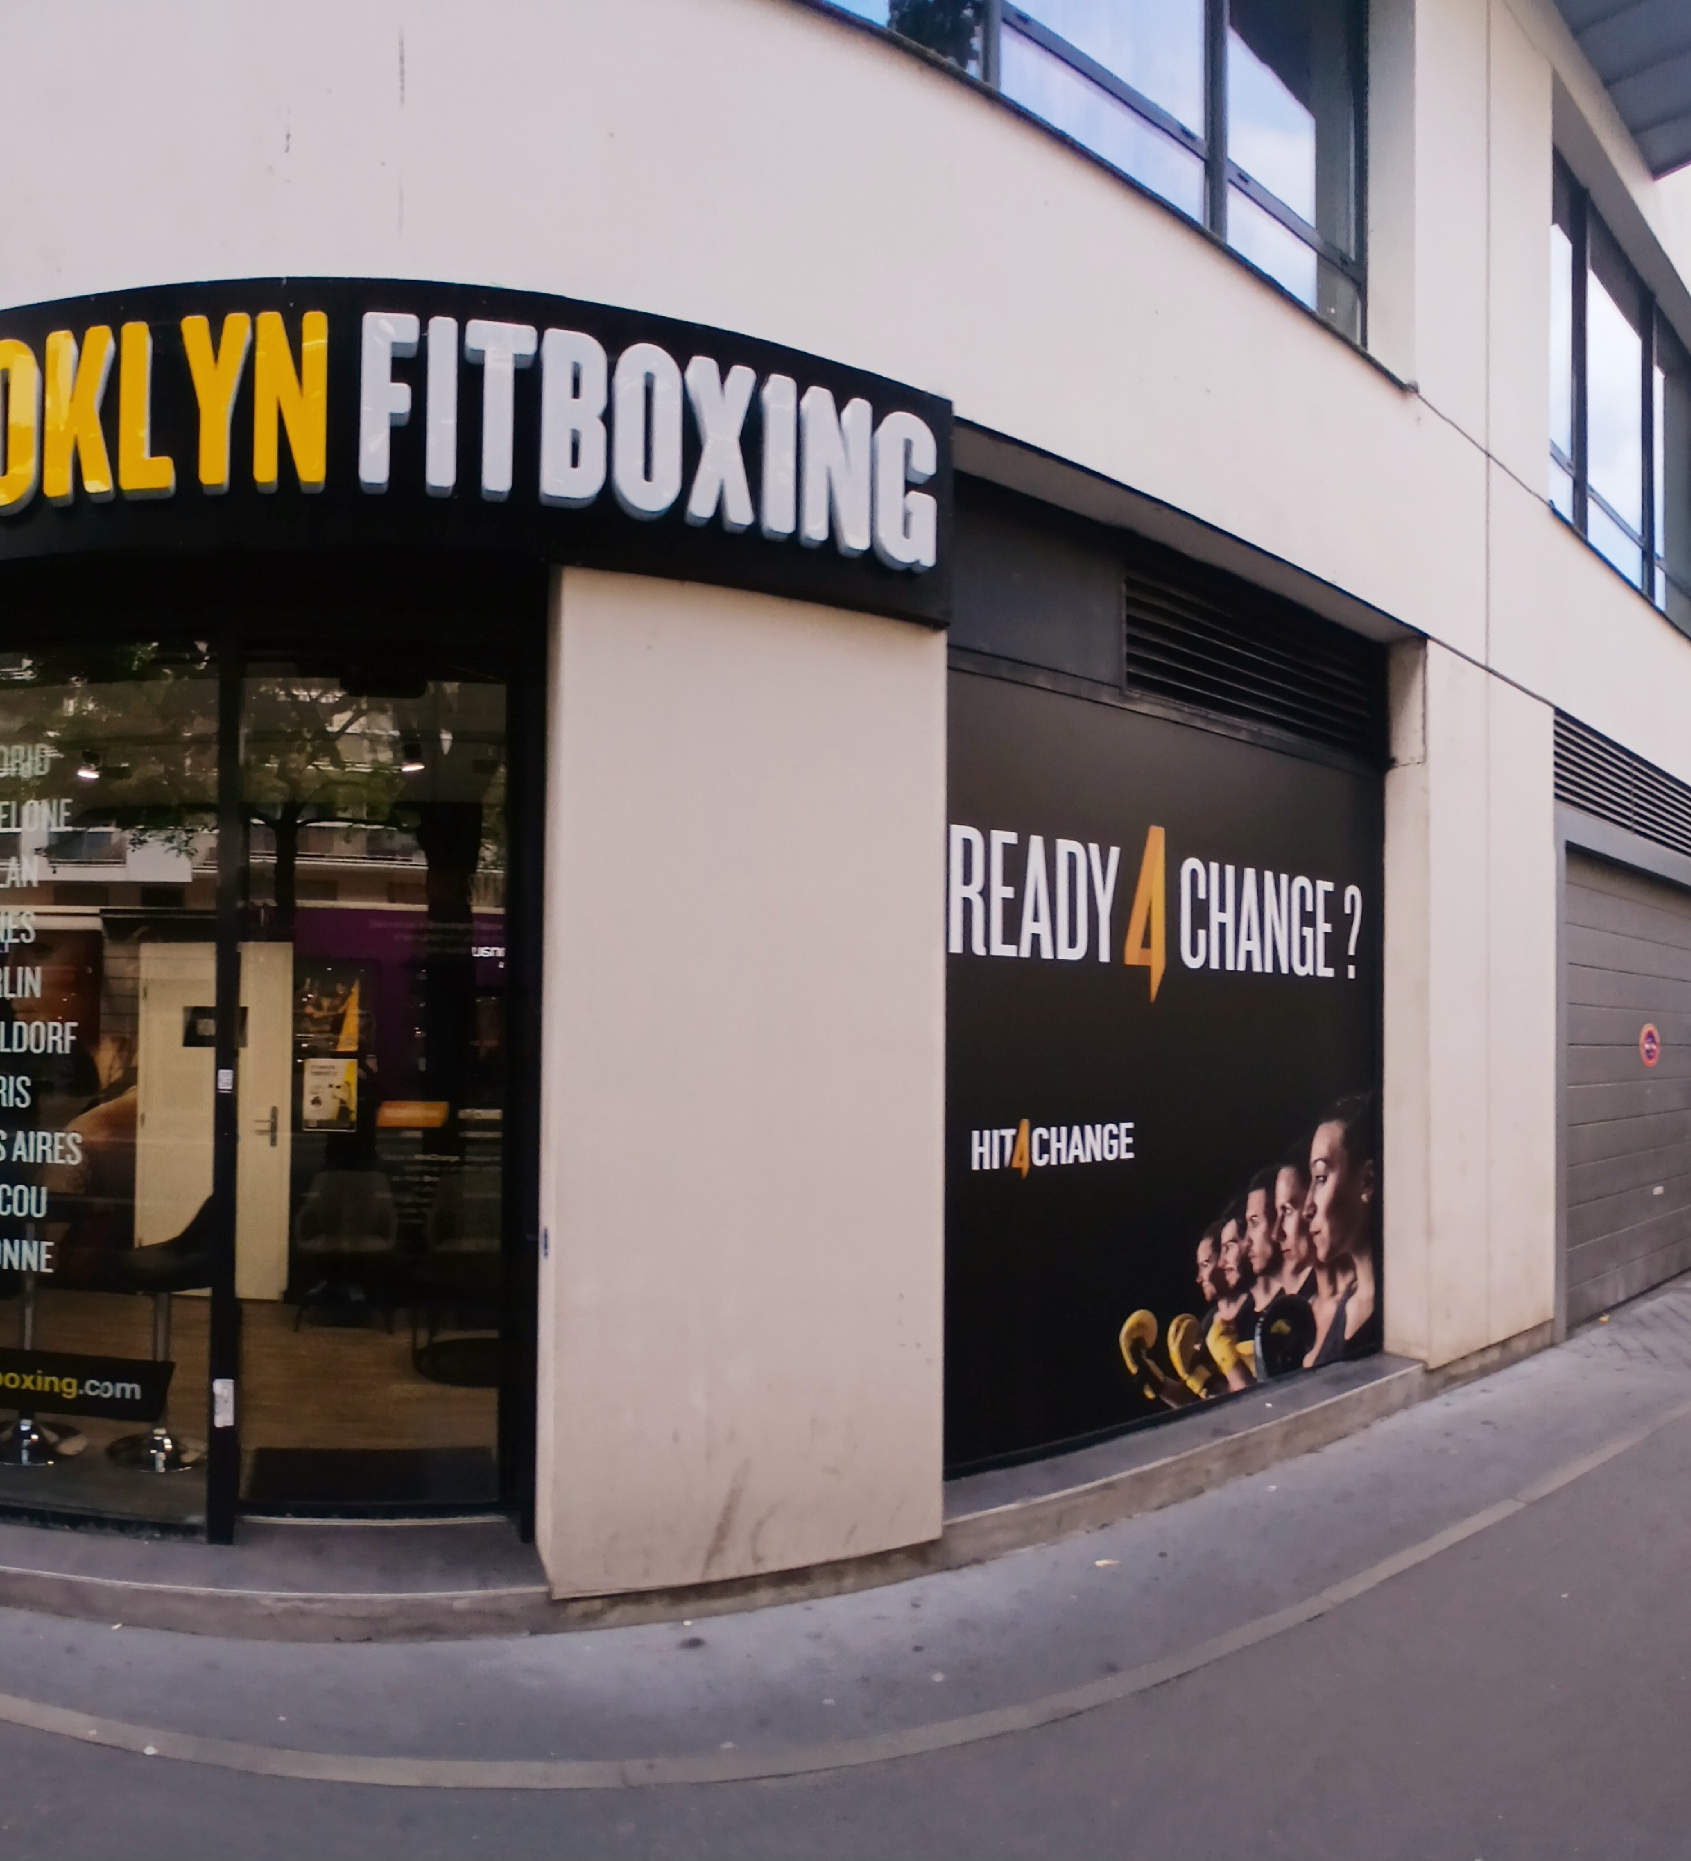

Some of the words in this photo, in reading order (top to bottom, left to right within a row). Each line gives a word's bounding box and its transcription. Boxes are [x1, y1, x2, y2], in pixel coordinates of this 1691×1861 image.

[358, 310, 940, 574] FITBOXING
[948, 823, 1121, 964] READY
[1124, 824, 1167, 1004] 4
[1180, 857, 1336, 979] CHANGE
[12, 1130, 83, 1166] AIRES
